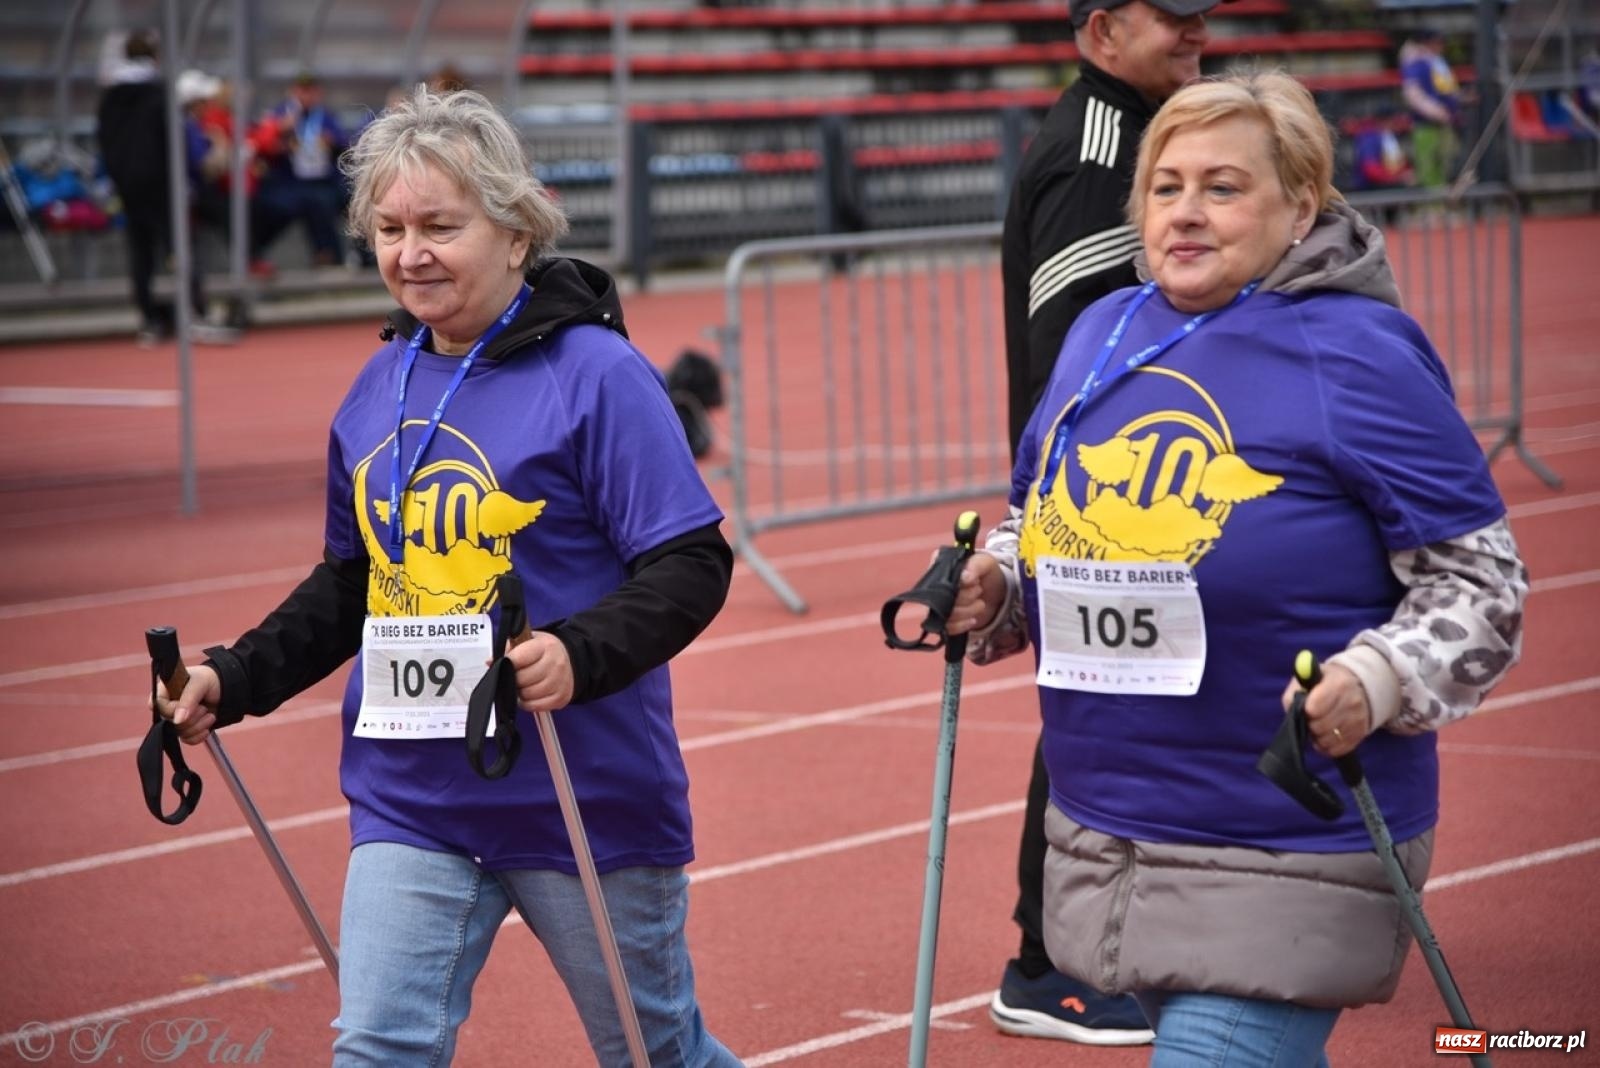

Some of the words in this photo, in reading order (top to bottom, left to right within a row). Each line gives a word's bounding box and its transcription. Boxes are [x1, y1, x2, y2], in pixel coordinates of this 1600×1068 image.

[1129, 432, 1207, 505] 10
[414, 482, 480, 553] 10
[1061, 566, 1090, 581] BIEG
[1094, 569, 1122, 583] BEZ
[1127, 570, 1186, 584] BARIER
[381, 625, 401, 638] BIEG
[403, 625, 424, 637] BEZ
[428, 623, 479, 637] BARIER
[1077, 604, 1159, 649] 105
[390, 658, 455, 698] 109
